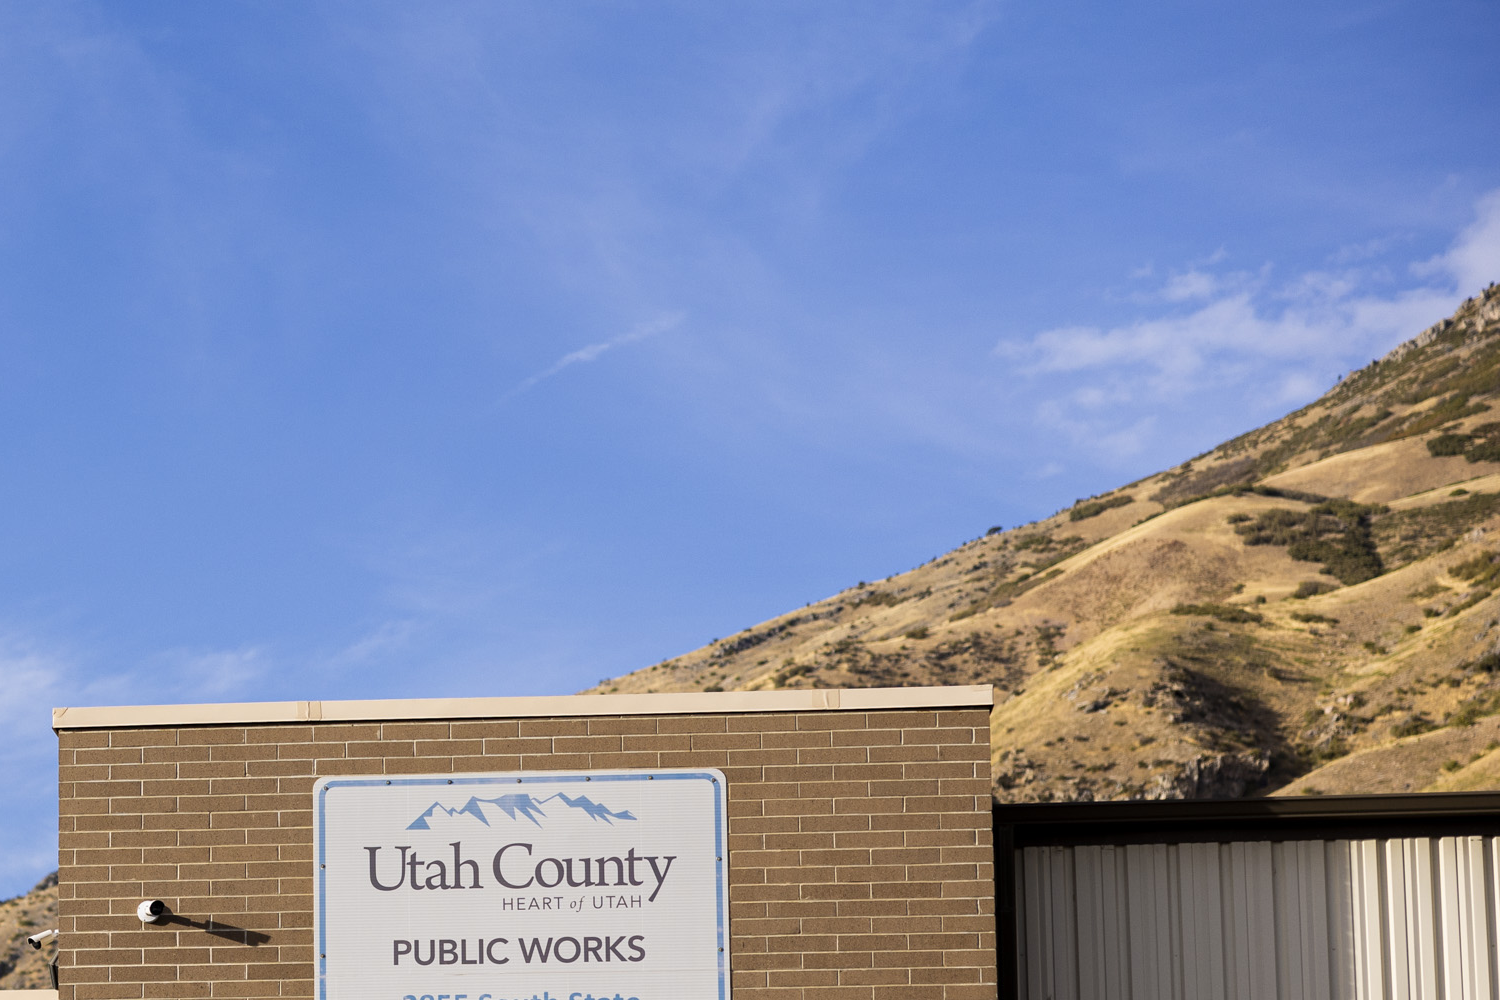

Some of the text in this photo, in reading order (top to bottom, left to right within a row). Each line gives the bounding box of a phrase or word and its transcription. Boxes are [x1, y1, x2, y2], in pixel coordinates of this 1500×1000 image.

[363, 841, 677, 903] Utah County
[502, 895, 642, 912] HEART of UTAH
[393, 935, 646, 966] PUBLIC WORKS
